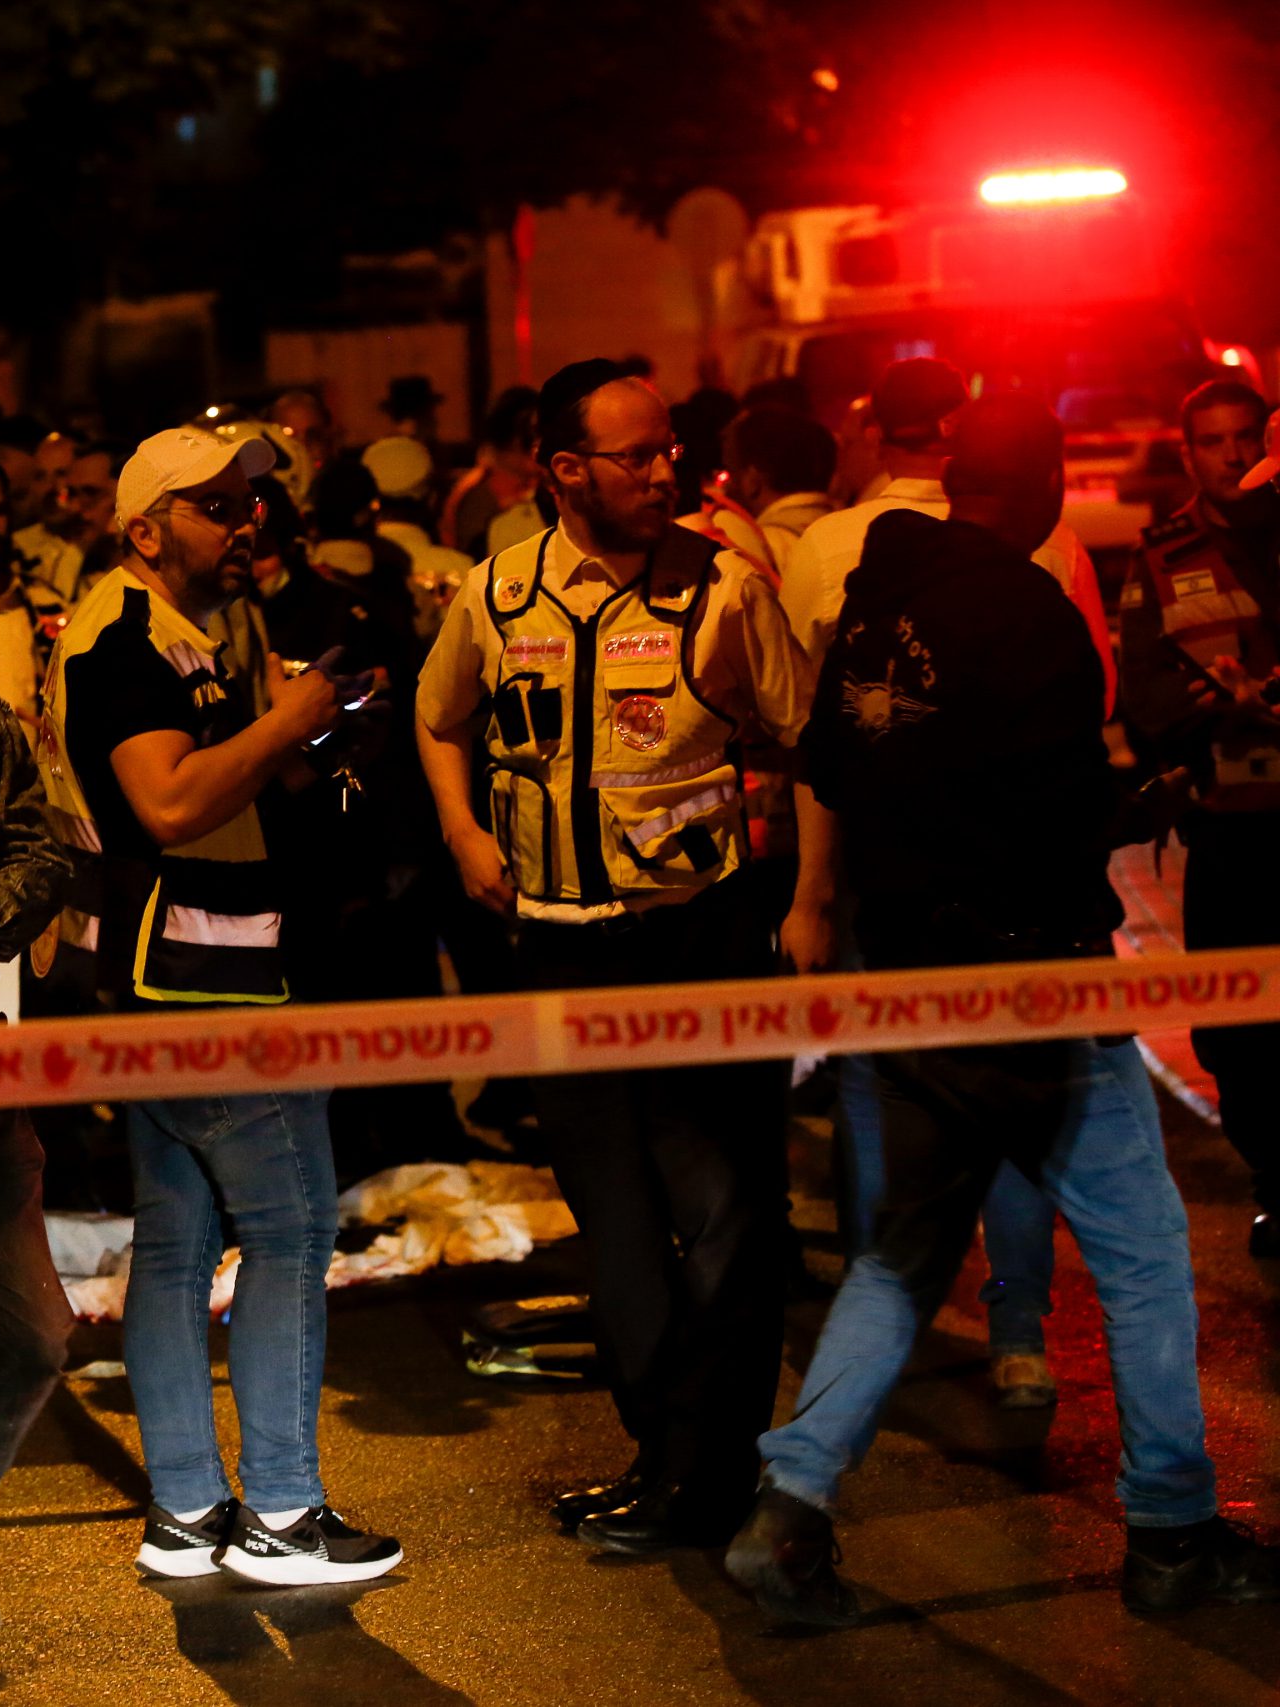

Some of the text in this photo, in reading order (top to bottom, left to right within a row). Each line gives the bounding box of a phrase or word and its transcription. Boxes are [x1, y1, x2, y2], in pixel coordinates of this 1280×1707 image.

[564, 969, 1261, 1046] משטרת ישראל אין מעבר
[88, 1035, 245, 1075] ישראל
[306, 1020, 493, 1065] משטרת
